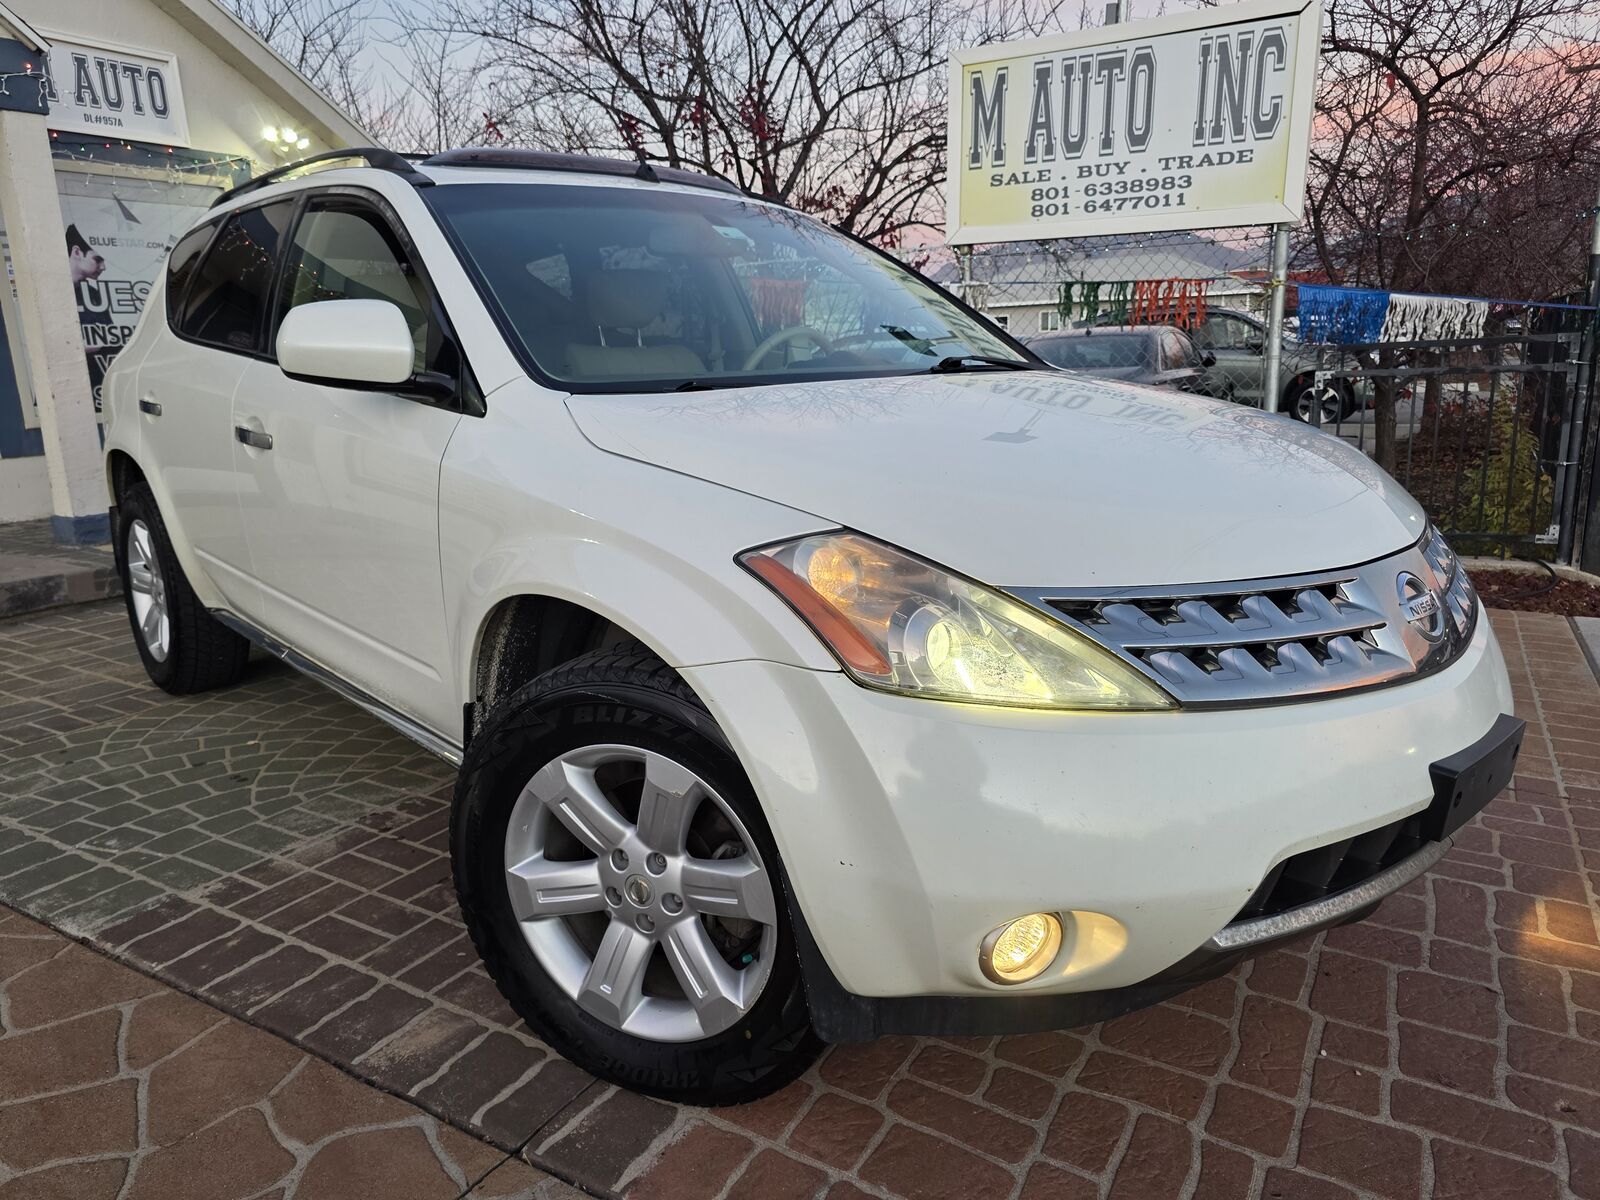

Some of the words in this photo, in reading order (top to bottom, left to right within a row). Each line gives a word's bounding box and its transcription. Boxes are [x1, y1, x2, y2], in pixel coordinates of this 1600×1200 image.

[71, 53, 170, 119] AUTO
[968, 66, 1009, 171] M
[1024, 45, 1157, 165] AUTO
[1192, 26, 1288, 147] INC
[990, 169, 1051, 187] SALE
[1077, 161, 1131, 180] BUY
[1158, 149, 1254, 172] TRADE
[1030, 175, 1193, 202] 801-6338983
[1030, 193, 1186, 218] 801-6477011
[83, 325, 136, 346] INSP
